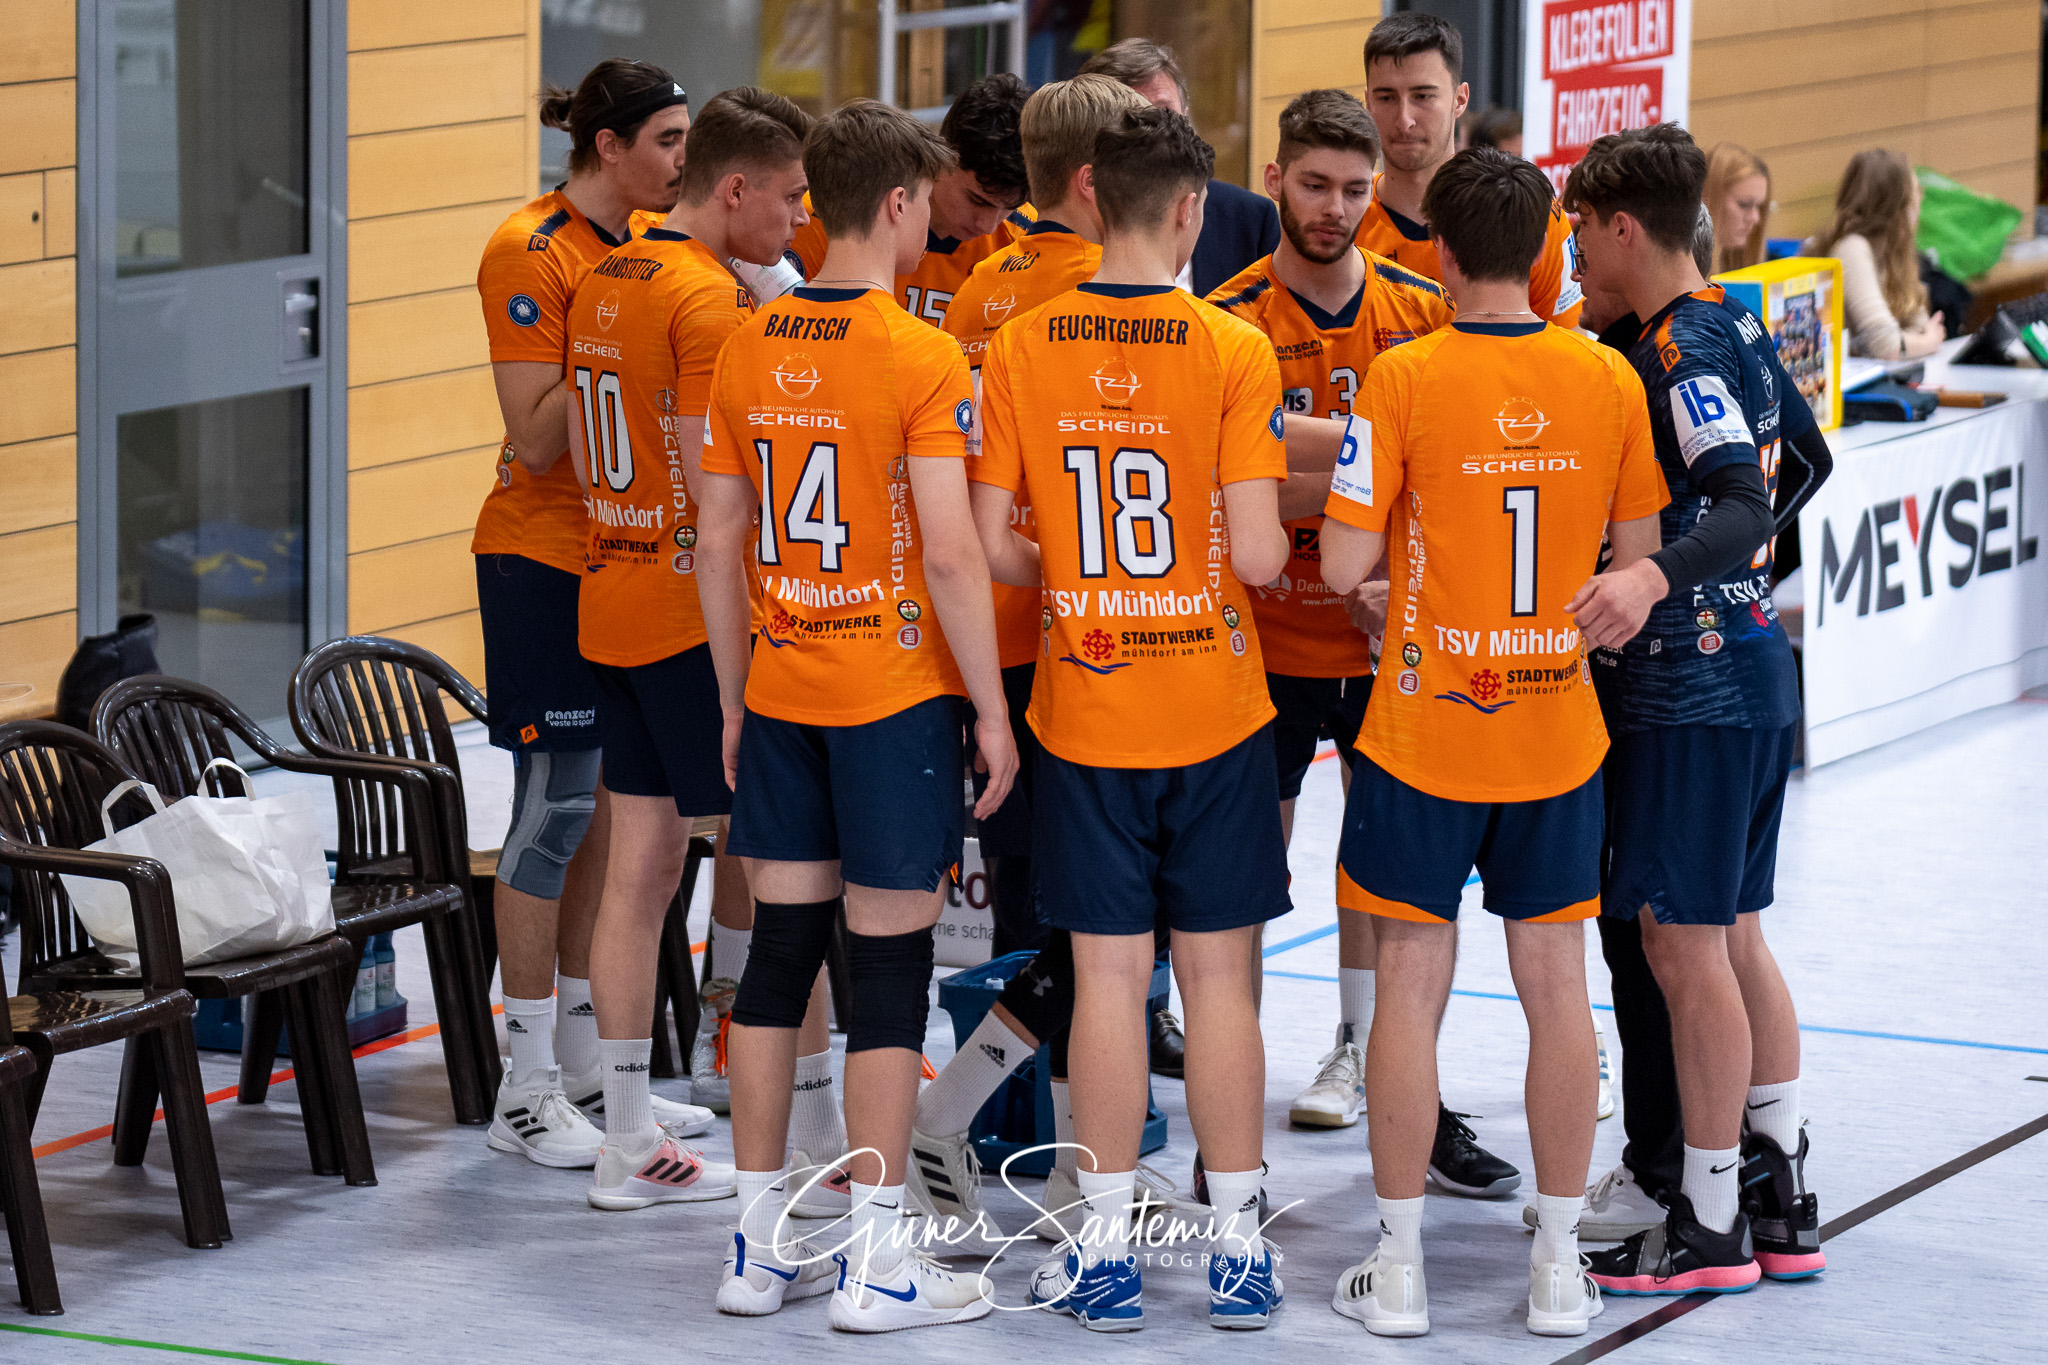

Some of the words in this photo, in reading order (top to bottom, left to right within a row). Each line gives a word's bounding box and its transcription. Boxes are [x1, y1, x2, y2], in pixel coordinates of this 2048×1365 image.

[1550, 0, 1668, 71] KLEBEFOLIEN
[1556, 83, 1659, 147] FAHRZEUG-
[905, 285, 955, 329] 15
[763, 313, 852, 341] BARTSCH
[1048, 314, 1189, 346] FEUCHTGRUBER
[573, 341, 623, 361] SCHEIDL
[1276, 338, 1323, 355] anzeri
[762, 405, 808, 414] REUNDLICHE
[1328, 366, 1358, 421] 3
[1677, 380, 1726, 428] ib
[574, 366, 635, 494] 10
[747, 412, 847, 430] SCHEIDL
[1057, 419, 1171, 435] SCHEIDL
[1461, 458, 1582, 474] SCHEIDL
[1483, 451, 1534, 460] FREUNDLICHE
[1535, 450, 1580, 458] AUTOHAUS
[752, 438, 850, 574] 14
[1063, 445, 1177, 580] 18
[887, 482, 906, 599] SCHEIDL
[1503, 486, 1540, 618] 1
[1816, 460, 2039, 629] MEYSEL
[777, 576, 885, 609] Mühldorf
[1049, 588, 1089, 618] TSV
[1098, 586, 1213, 618] Mühldorf
[790, 614, 882, 633] STADTWERKE
[1121, 627, 1215, 645] STADTWERKE
[1121, 648, 1176, 658] mühldorf
[1434, 624, 1481, 657] TSV
[1489, 627, 1580, 657] Mühldor
[1506, 659, 1578, 684] STADTWERKE
[1506, 684, 1559, 696] mühldorf
[793, 1076, 833, 1092] adidas
